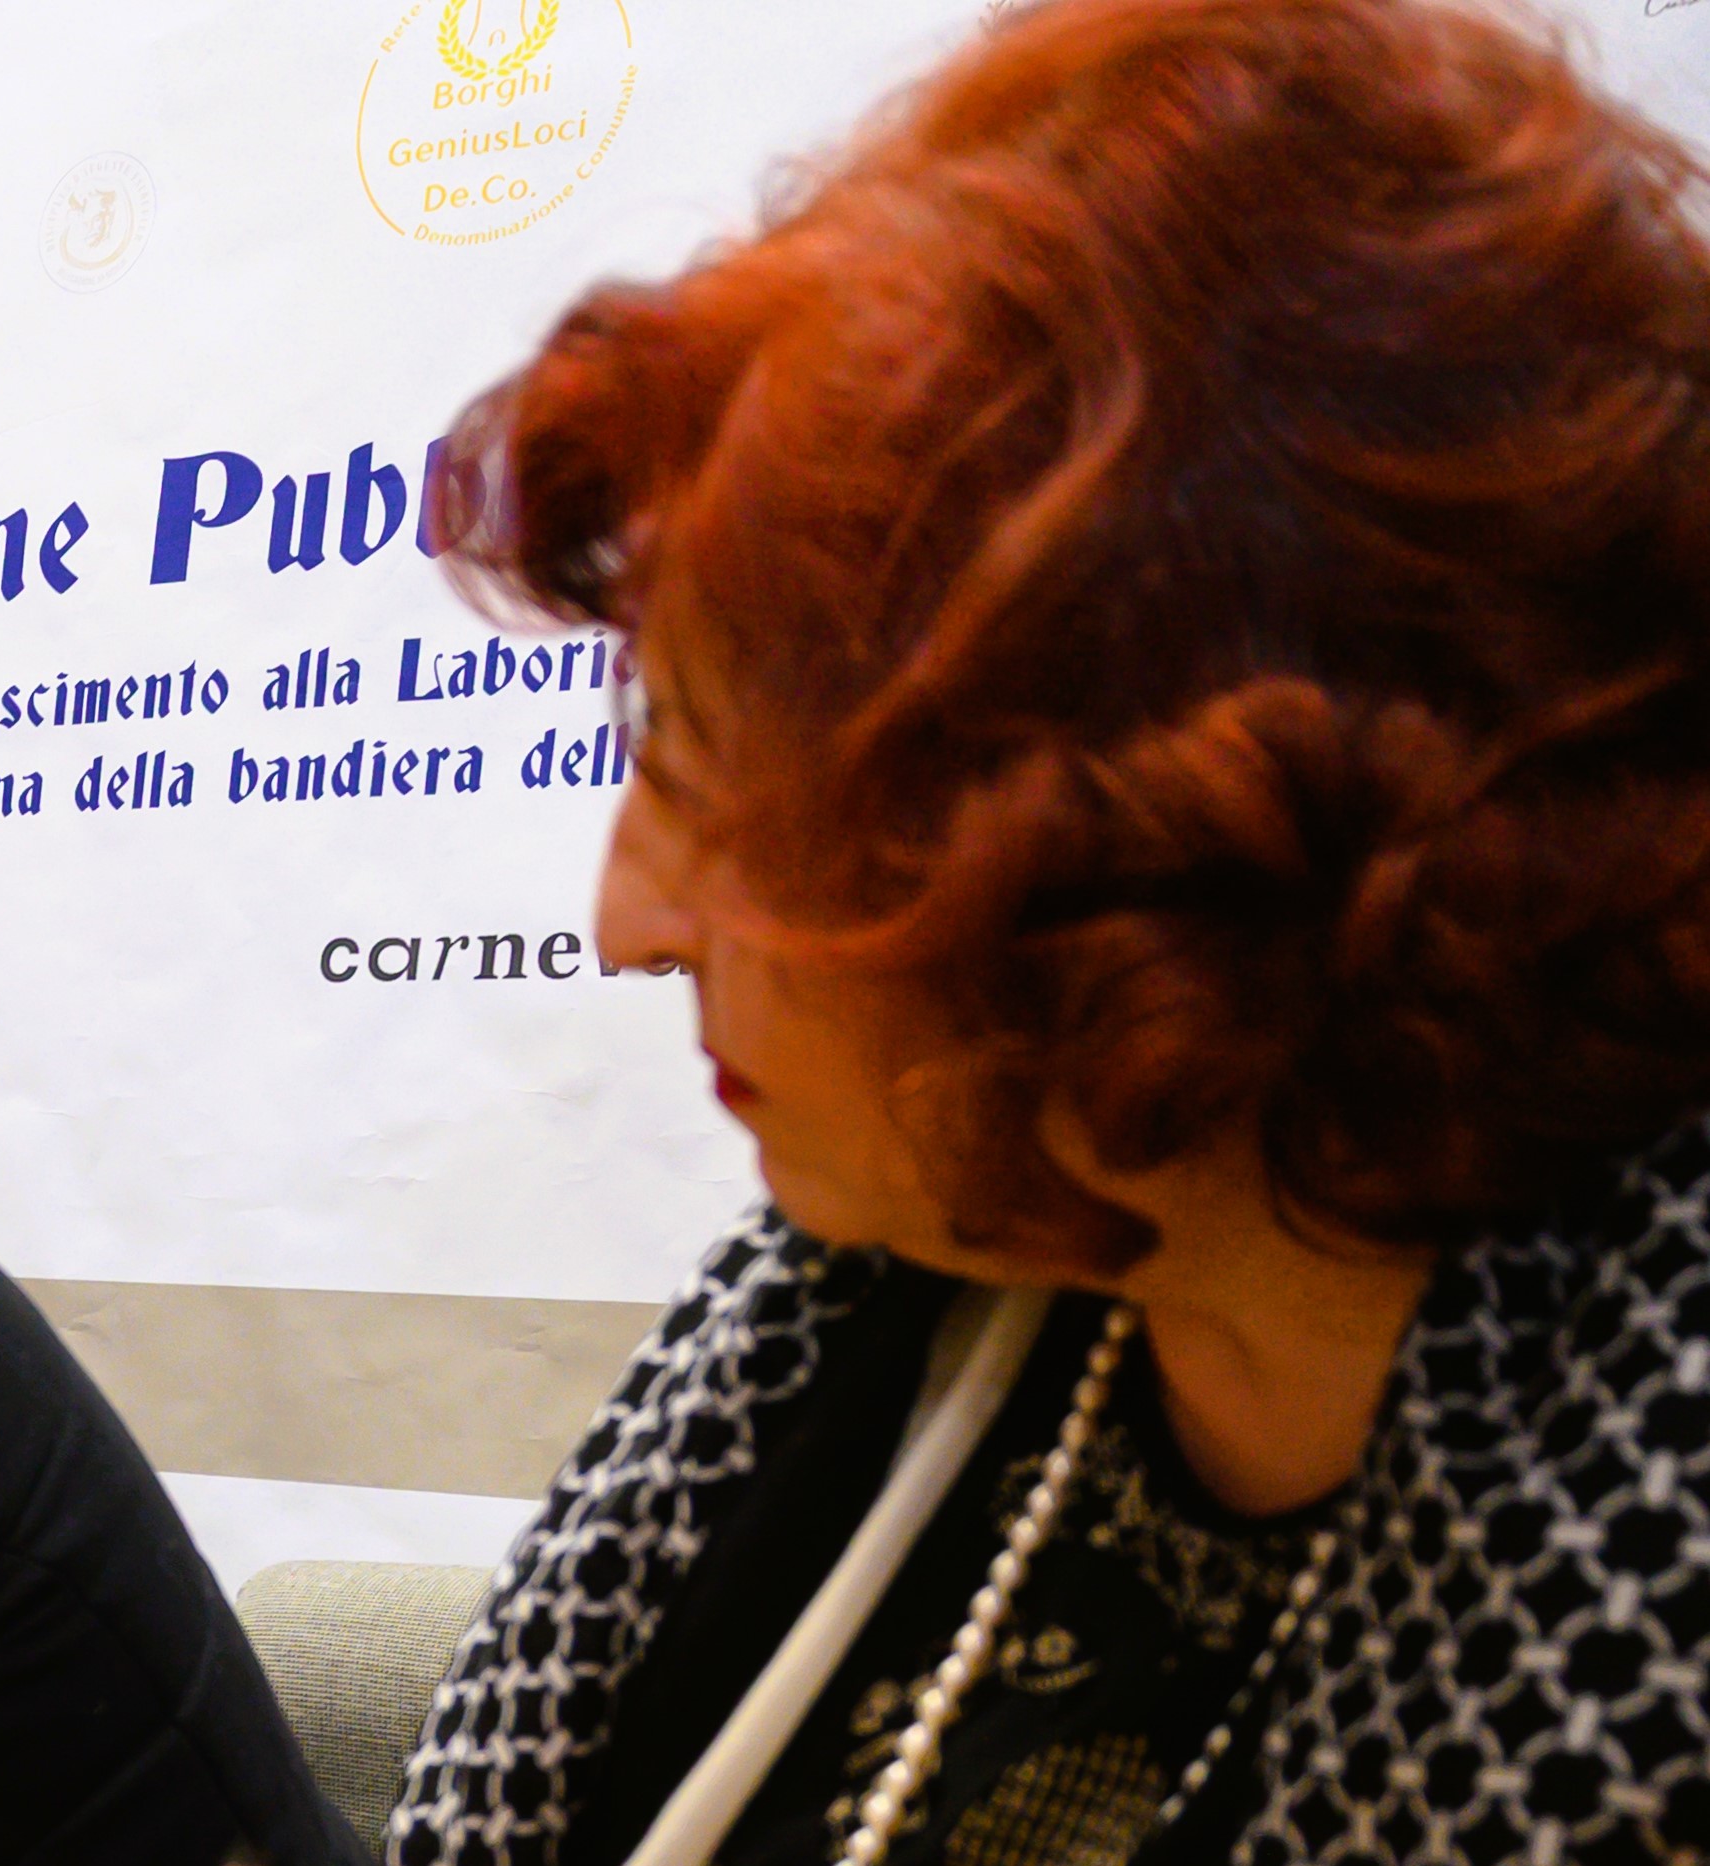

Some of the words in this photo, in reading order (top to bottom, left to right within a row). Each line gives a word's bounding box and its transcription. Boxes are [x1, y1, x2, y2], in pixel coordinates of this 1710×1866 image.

[379, 4, 422, 53] Rete
[432, 63, 553, 110] Borghi
[387, 110, 588, 167] GeniusLoci
[413, 182, 575, 247] Denominazione
[575, 64, 639, 181] Comunale
[423, 174, 537, 212] De.Co.
[262, 644, 362, 711] alla
[74, 750, 195, 812] della
[228, 737, 484, 806] bandiera
[520, 722, 631, 790] dell
[319, 931, 692, 984] carne
